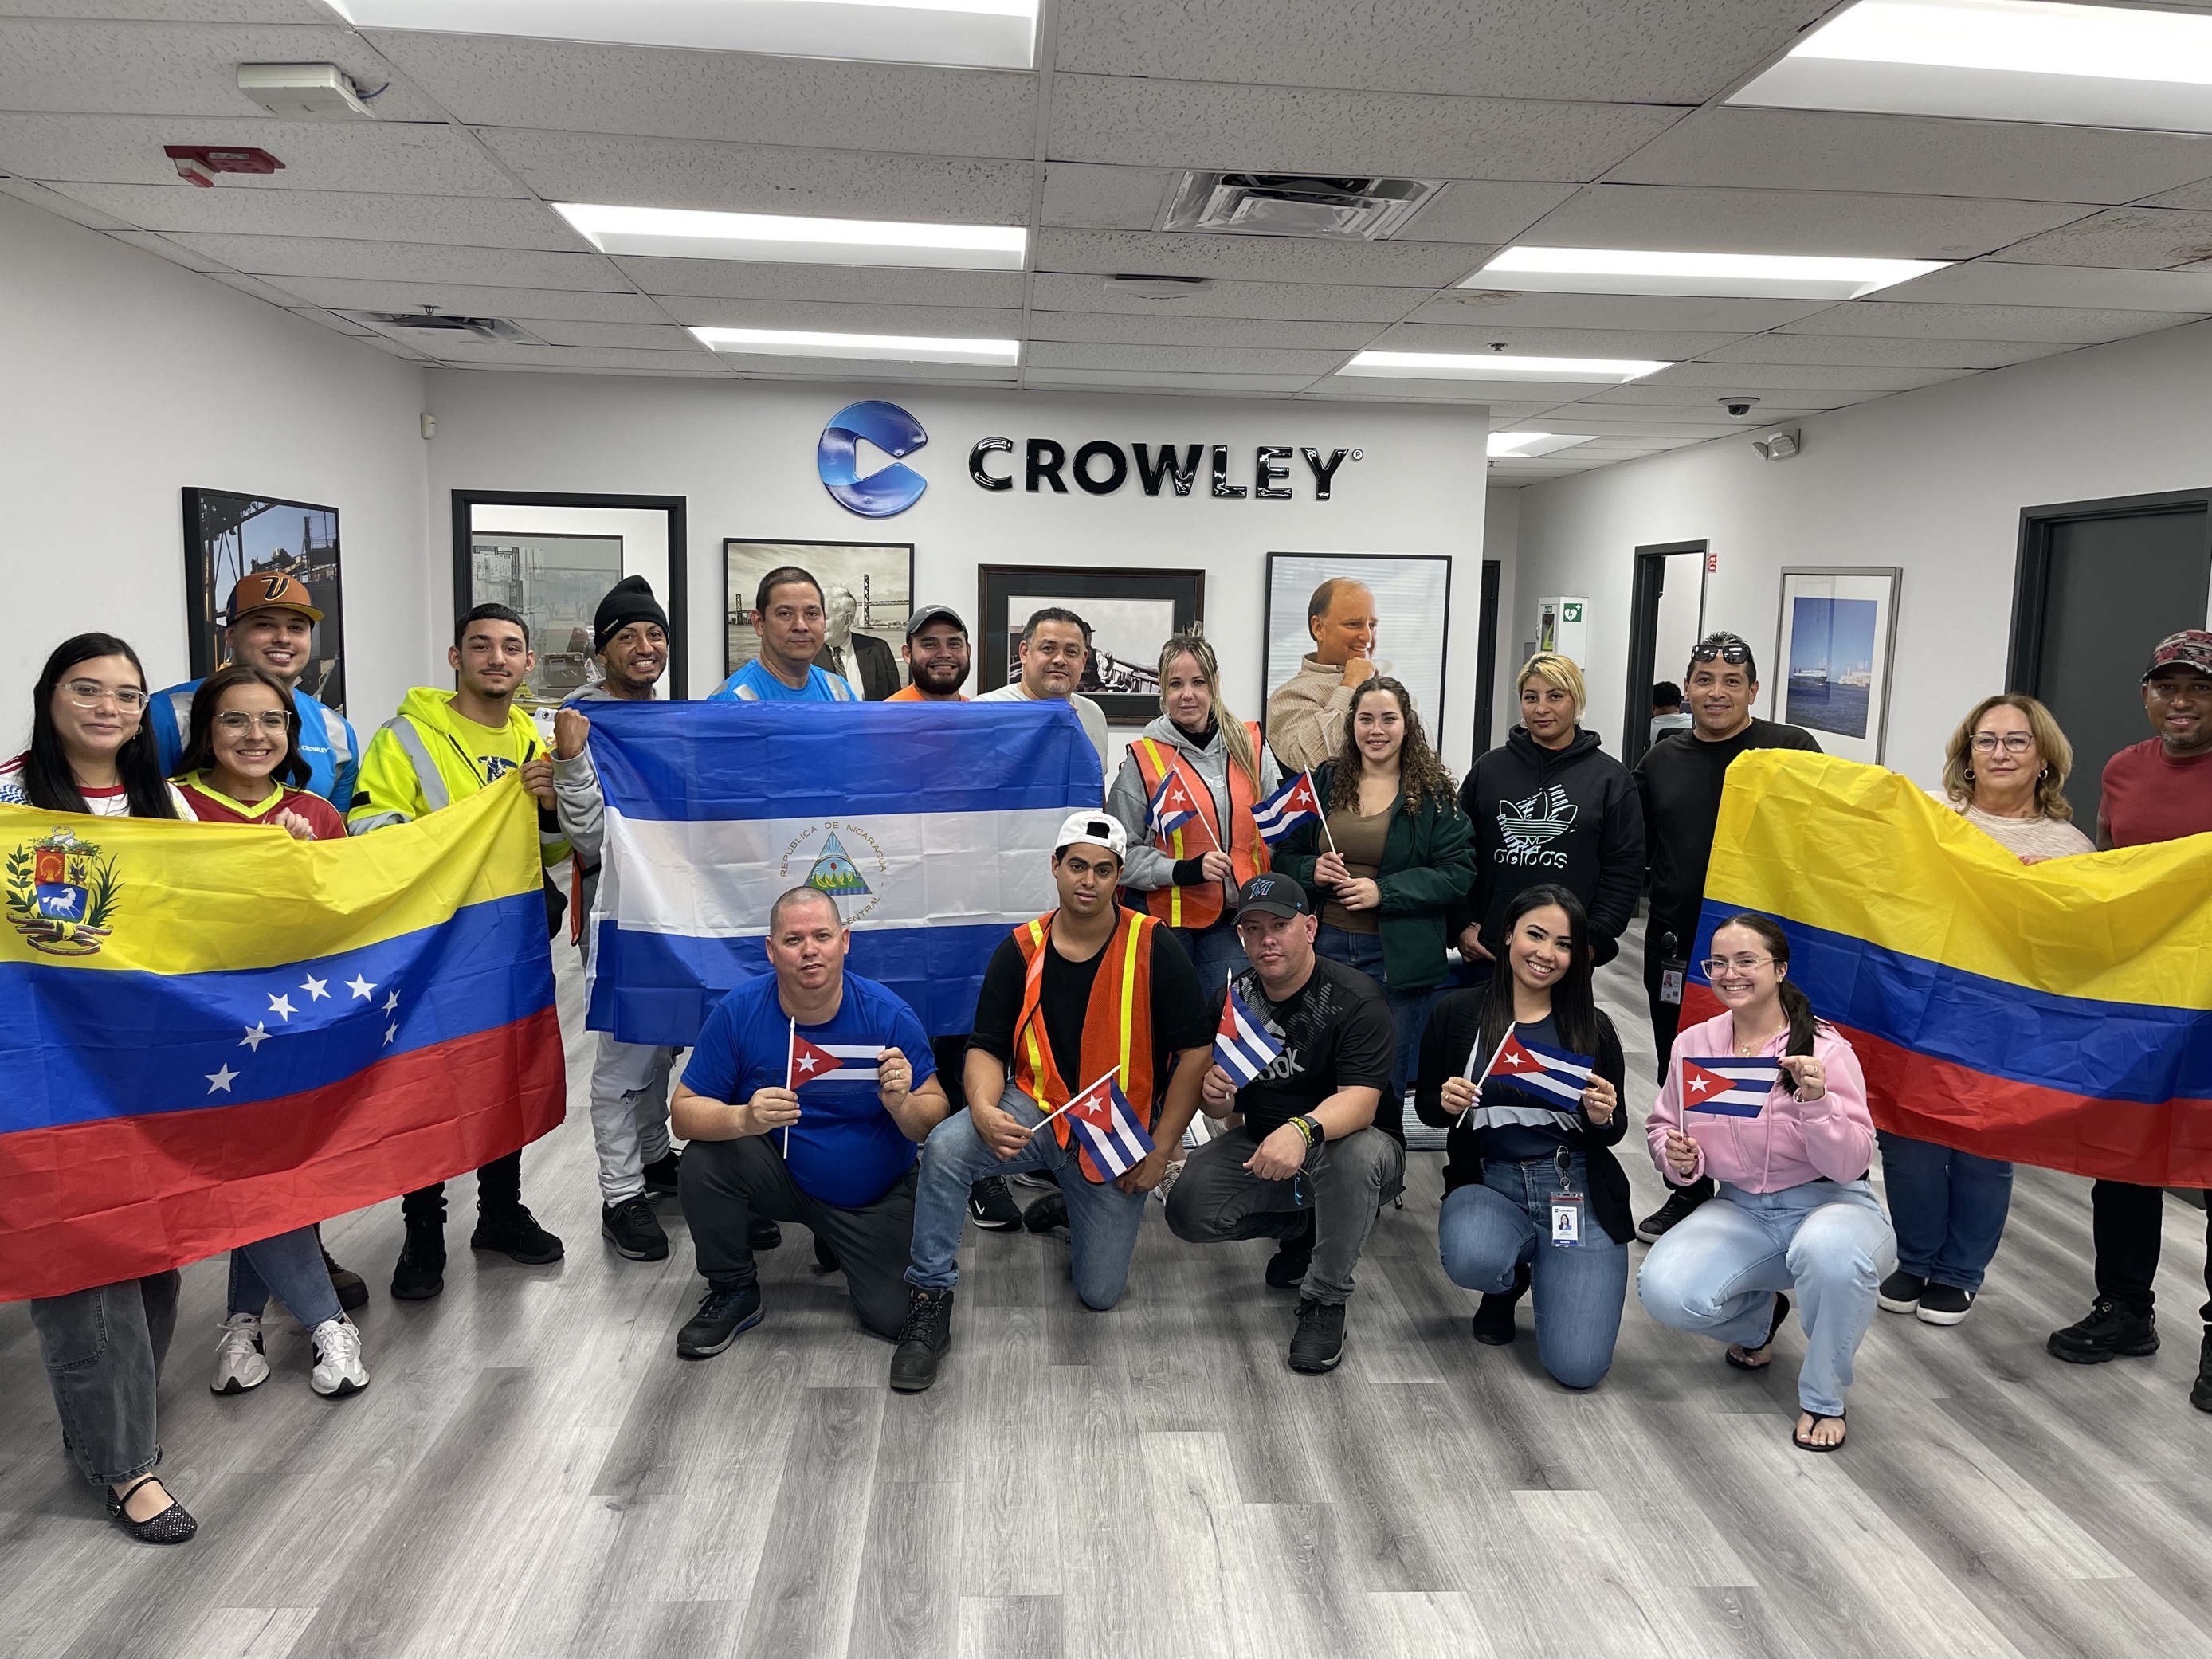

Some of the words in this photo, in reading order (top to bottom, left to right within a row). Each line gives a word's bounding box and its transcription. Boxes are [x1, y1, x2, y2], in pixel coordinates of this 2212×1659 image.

[780, 826, 819, 877] REPUBLICA
[846, 823, 887, 873] NICARAGUA
[840, 896, 881, 926] CENTRAL
